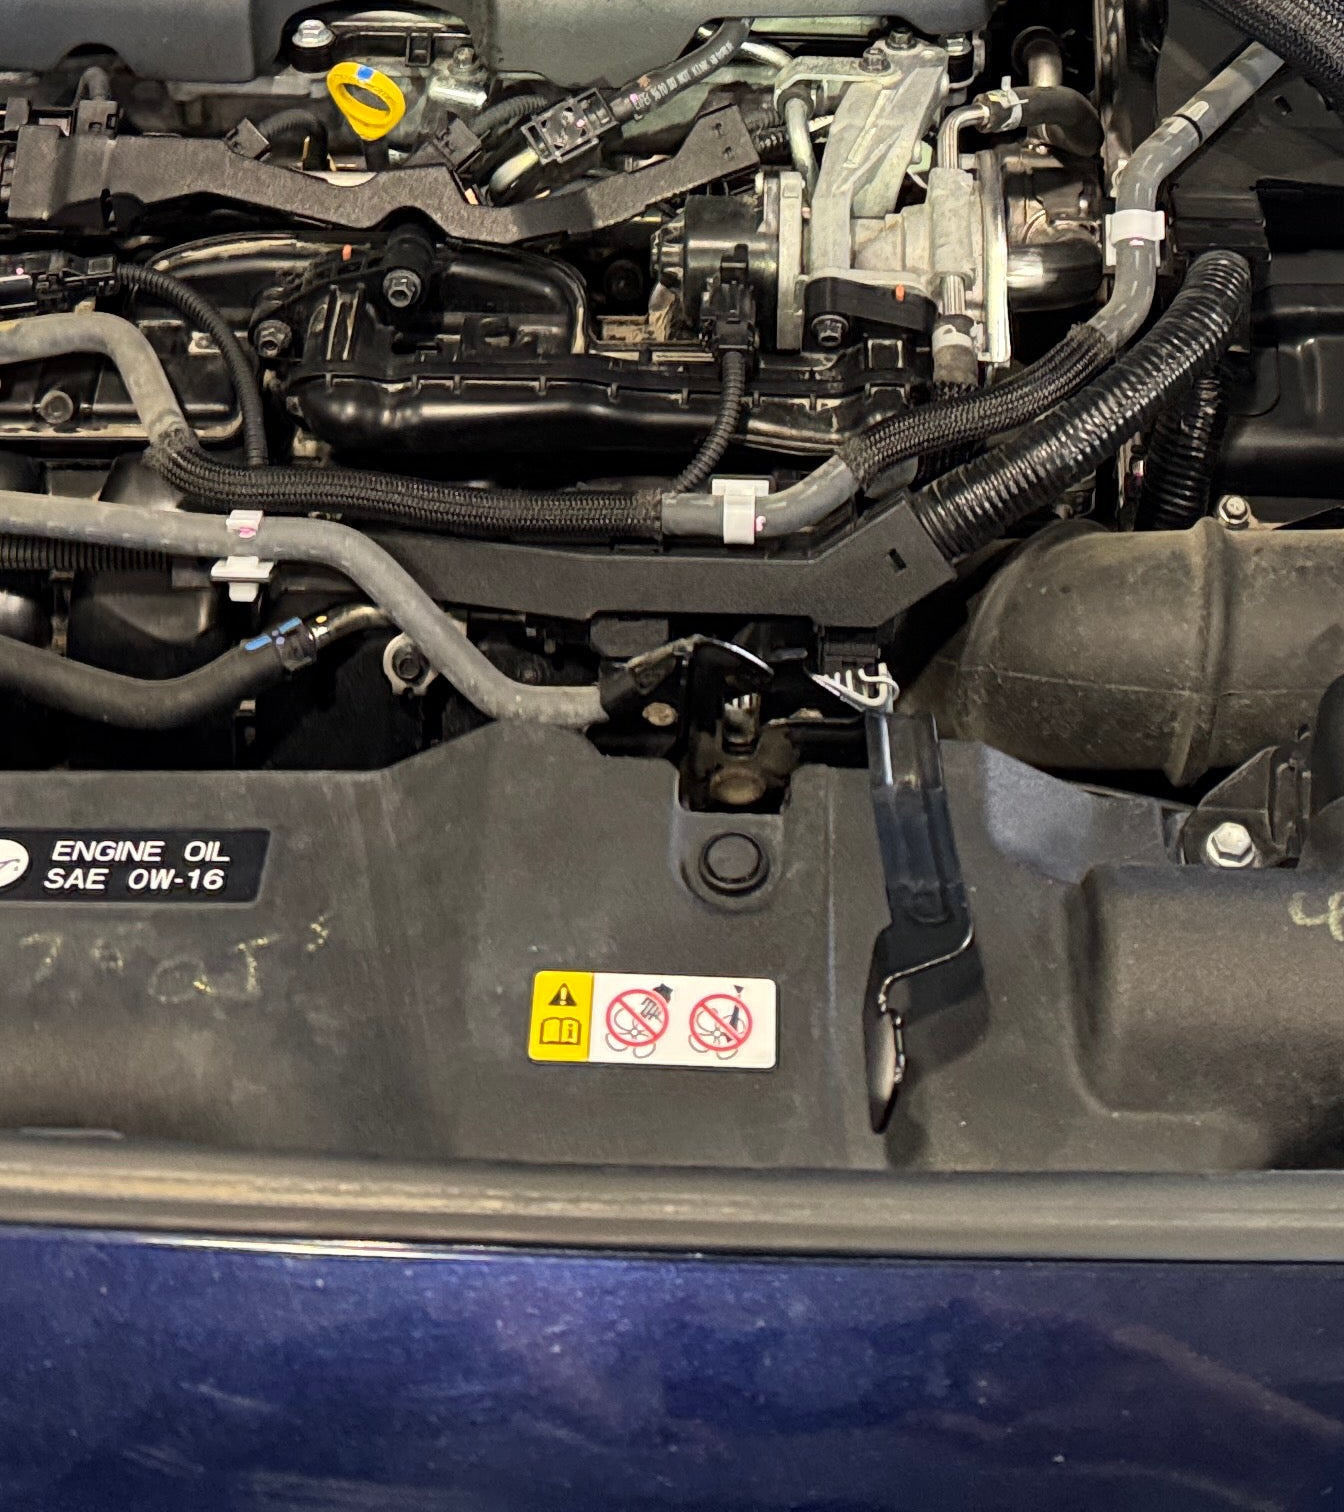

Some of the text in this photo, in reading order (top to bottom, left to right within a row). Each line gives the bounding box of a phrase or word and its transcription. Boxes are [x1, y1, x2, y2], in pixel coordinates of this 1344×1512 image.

[51, 840, 231, 863] ENGINE OIL
[43, 867, 225, 890] SAE 0W-16
